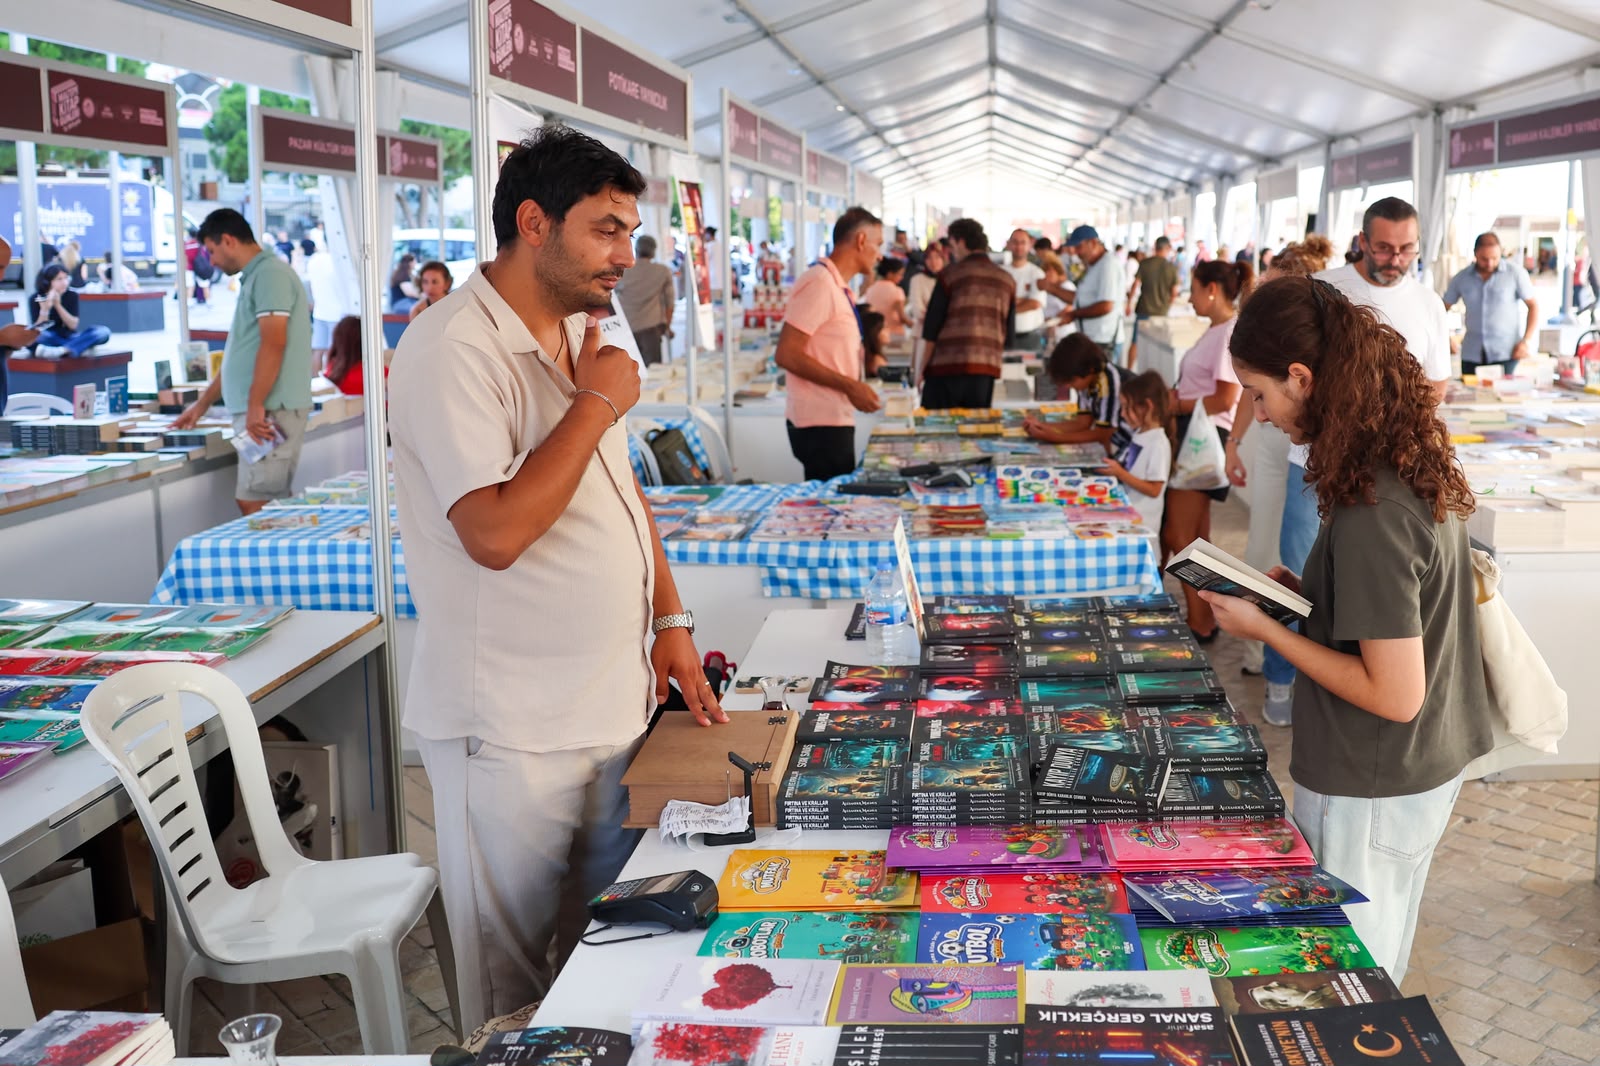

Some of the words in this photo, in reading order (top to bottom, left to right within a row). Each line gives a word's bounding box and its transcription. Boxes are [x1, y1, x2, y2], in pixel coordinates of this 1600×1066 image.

[1050, 747, 1078, 769] DÜNYA
[1042, 768, 1069, 789] KAYIP
[760, 862, 782, 889] MUTFAK
[966, 879, 981, 907] MESLEKLER
[965, 927, 992, 963] UTBOL
[1197, 939, 1216, 962] BİTKİLER
[1038, 1010, 1146, 1024] GERÇEKLİK
[1150, 1012, 1213, 1023] SANAL
[771, 1032, 794, 1060] HANE
[869, 1028, 886, 1066] SHANESİ
[1258, 1024, 1279, 1058] İSTİHBARATIN
[1290, 1020, 1318, 1062] POLİTİKALARI
[1304, 1021, 1323, 1046] ETKİLERİ
